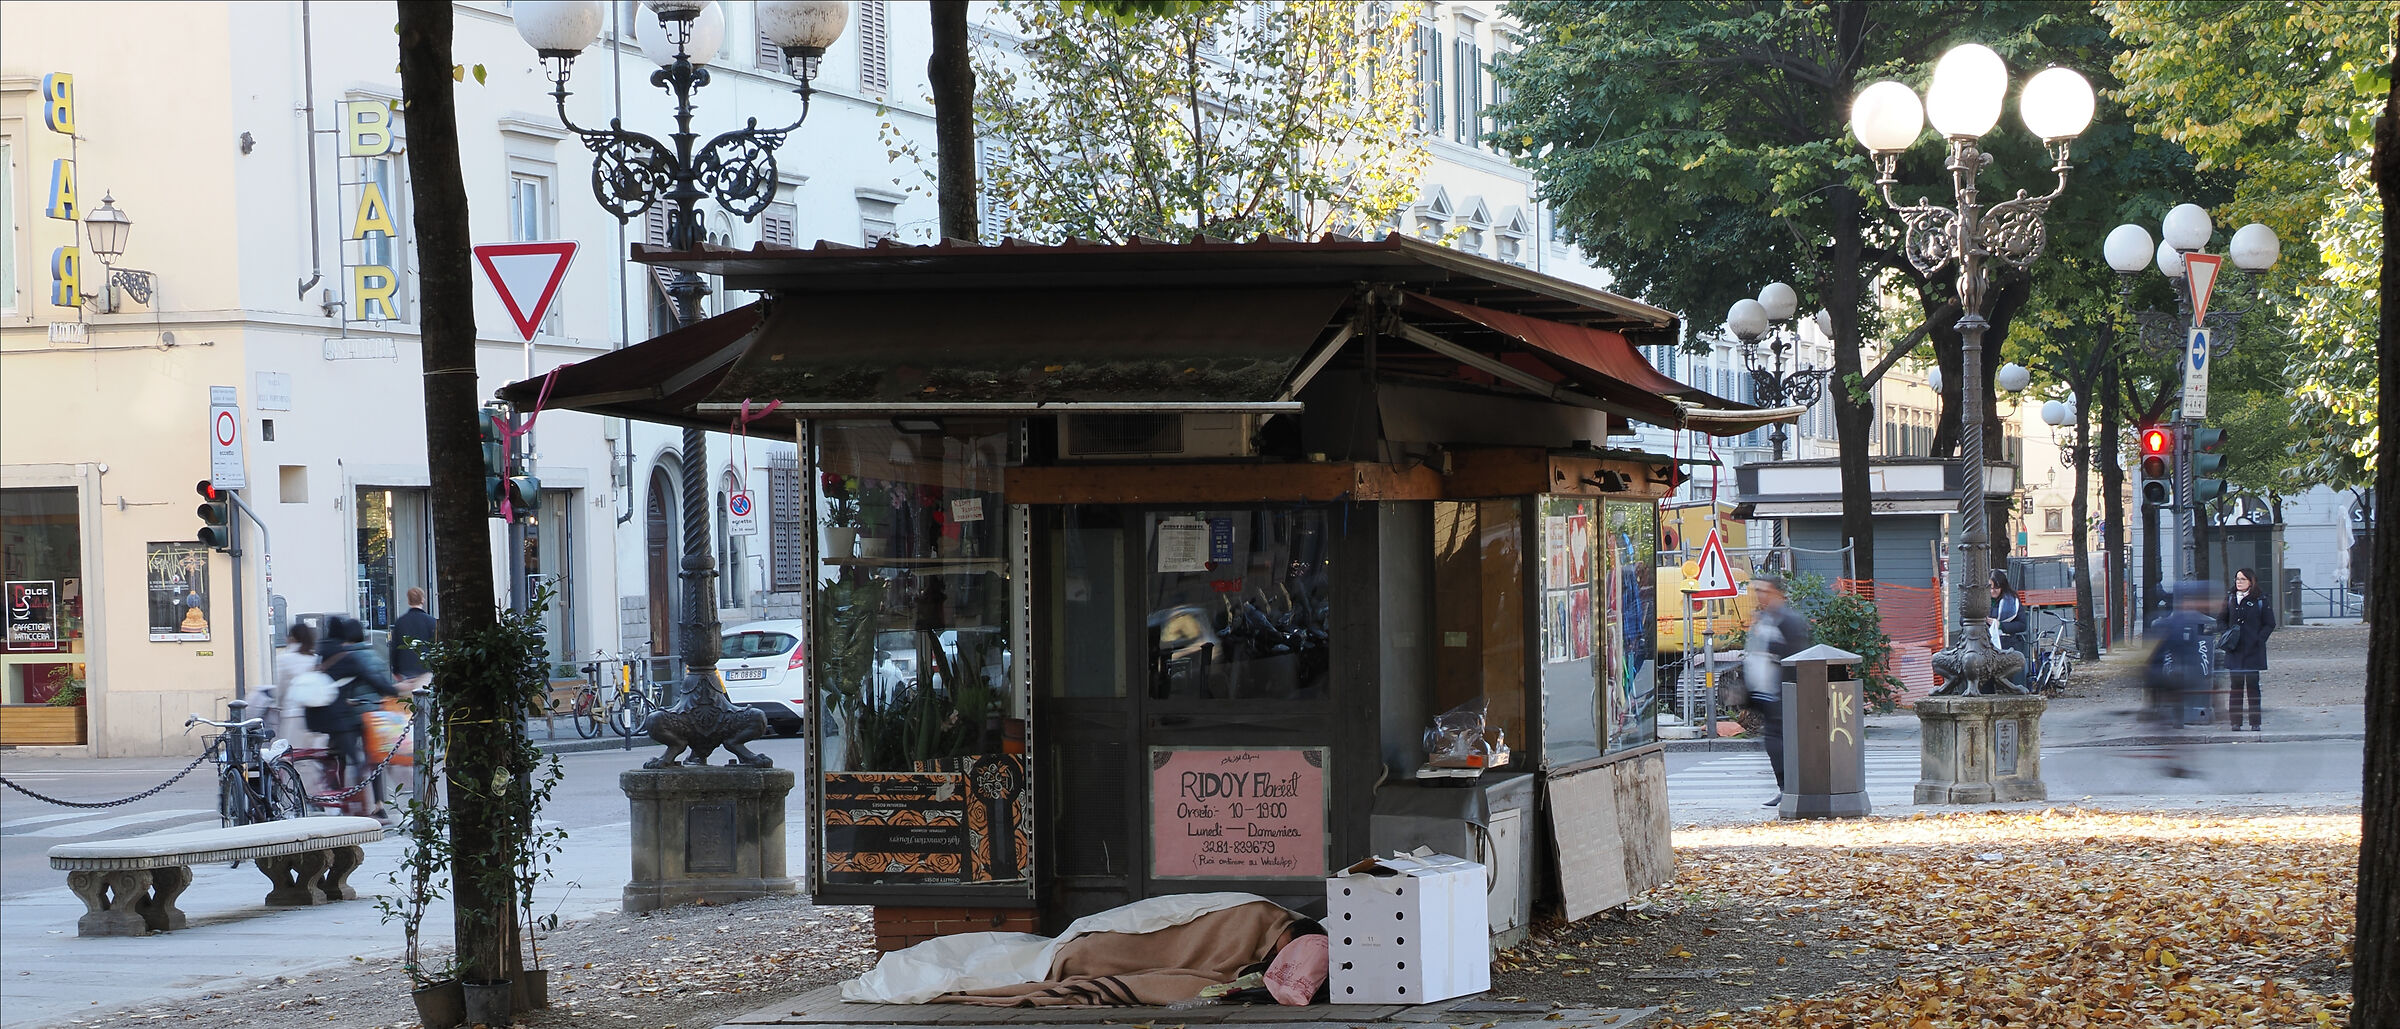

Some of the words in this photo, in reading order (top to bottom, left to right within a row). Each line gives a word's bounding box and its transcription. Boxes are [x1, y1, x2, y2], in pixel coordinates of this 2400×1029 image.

[347, 101, 400, 321] BAR
[15, 585, 49, 607] DOLCE
[12, 623, 51, 631] CAFFETTERIA
[1181, 771, 1250, 802] RIDOY
[1248, 822, 1301, 838] Domenica
[889, 836, 914, 845] Flowers
